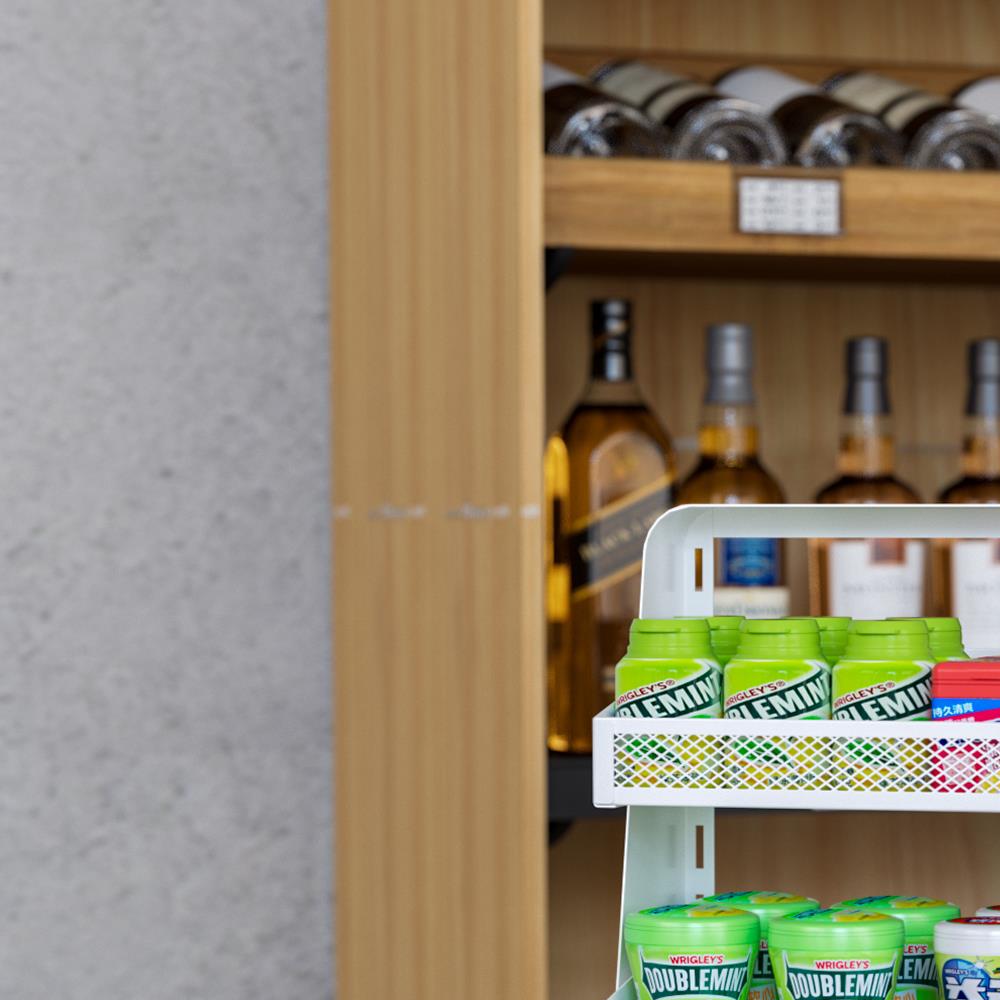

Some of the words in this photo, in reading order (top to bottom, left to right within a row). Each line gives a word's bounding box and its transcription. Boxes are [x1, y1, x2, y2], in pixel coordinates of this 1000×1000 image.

[670, 955, 724, 965] WRIGLEY'S
[815, 960, 870, 970] WRIGLEY'S
[643, 966, 748, 993] DOUBLEMINT
[788, 971, 893, 1000] DOUBLEMINT
